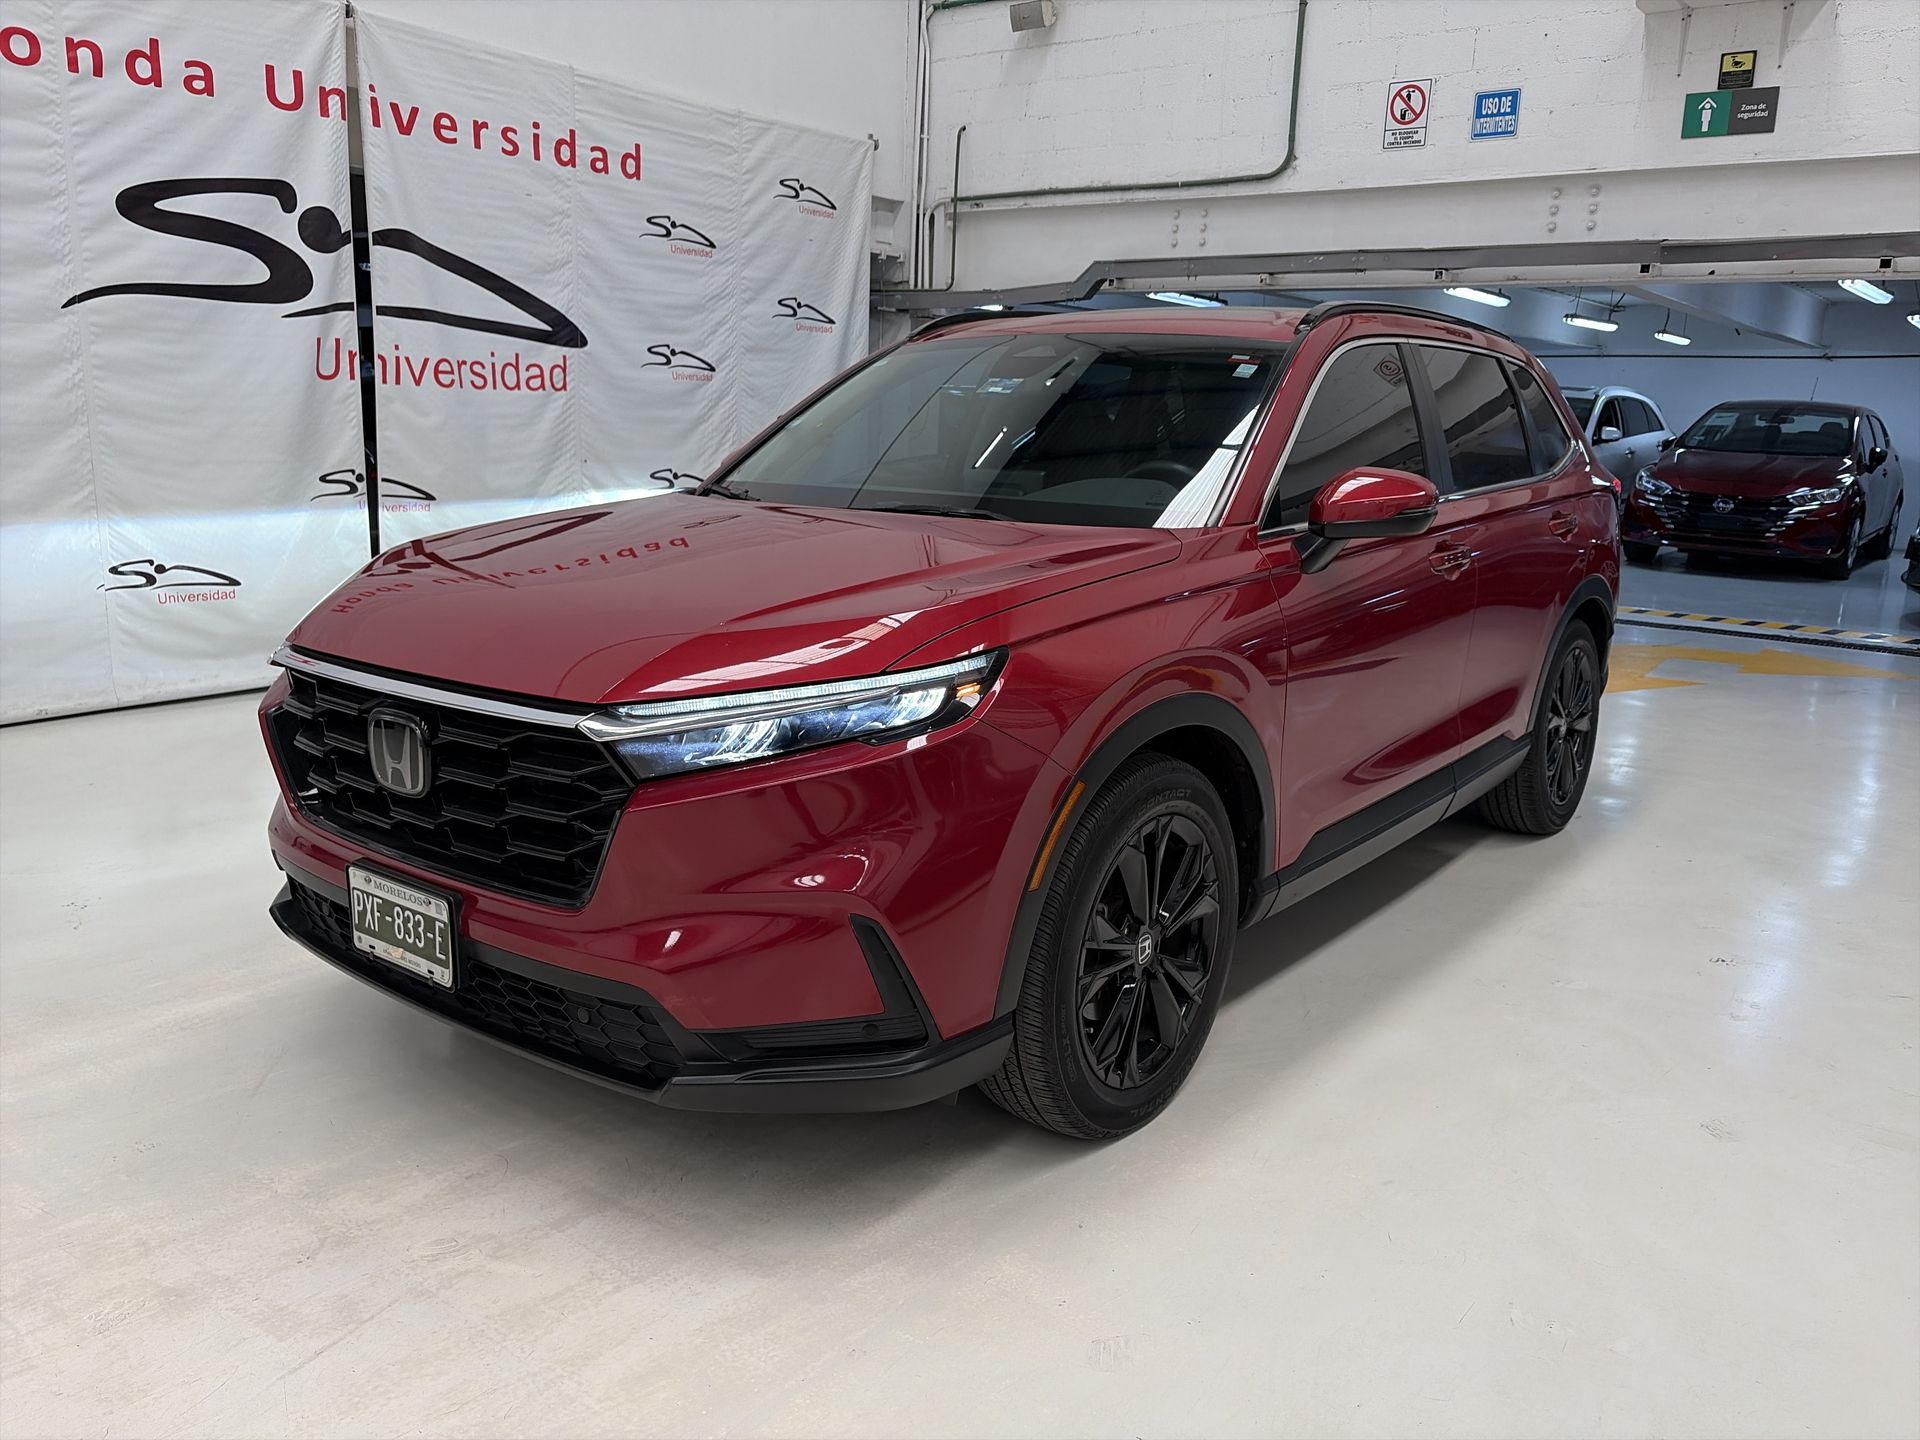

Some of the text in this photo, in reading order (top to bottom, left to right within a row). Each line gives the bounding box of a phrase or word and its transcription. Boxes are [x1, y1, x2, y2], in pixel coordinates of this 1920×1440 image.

[1482, 96, 1512, 114] USO DE
[1741, 103, 1757, 111] Zona
[265, 64, 641, 180] Universidad
[1737, 110, 1768, 120] seguridad
[1474, 115, 1516, 134] INTERMITENTES
[798, 205, 835, 219] Universidad
[670, 245, 713, 258] Universidad
[795, 322, 833, 334] Universidad
[671, 371, 713, 382] Universidad
[157, 588, 236, 605] Universidad
[373, 881, 424, 906] MORELOS
[353, 889, 447, 961] PXF-833-E
